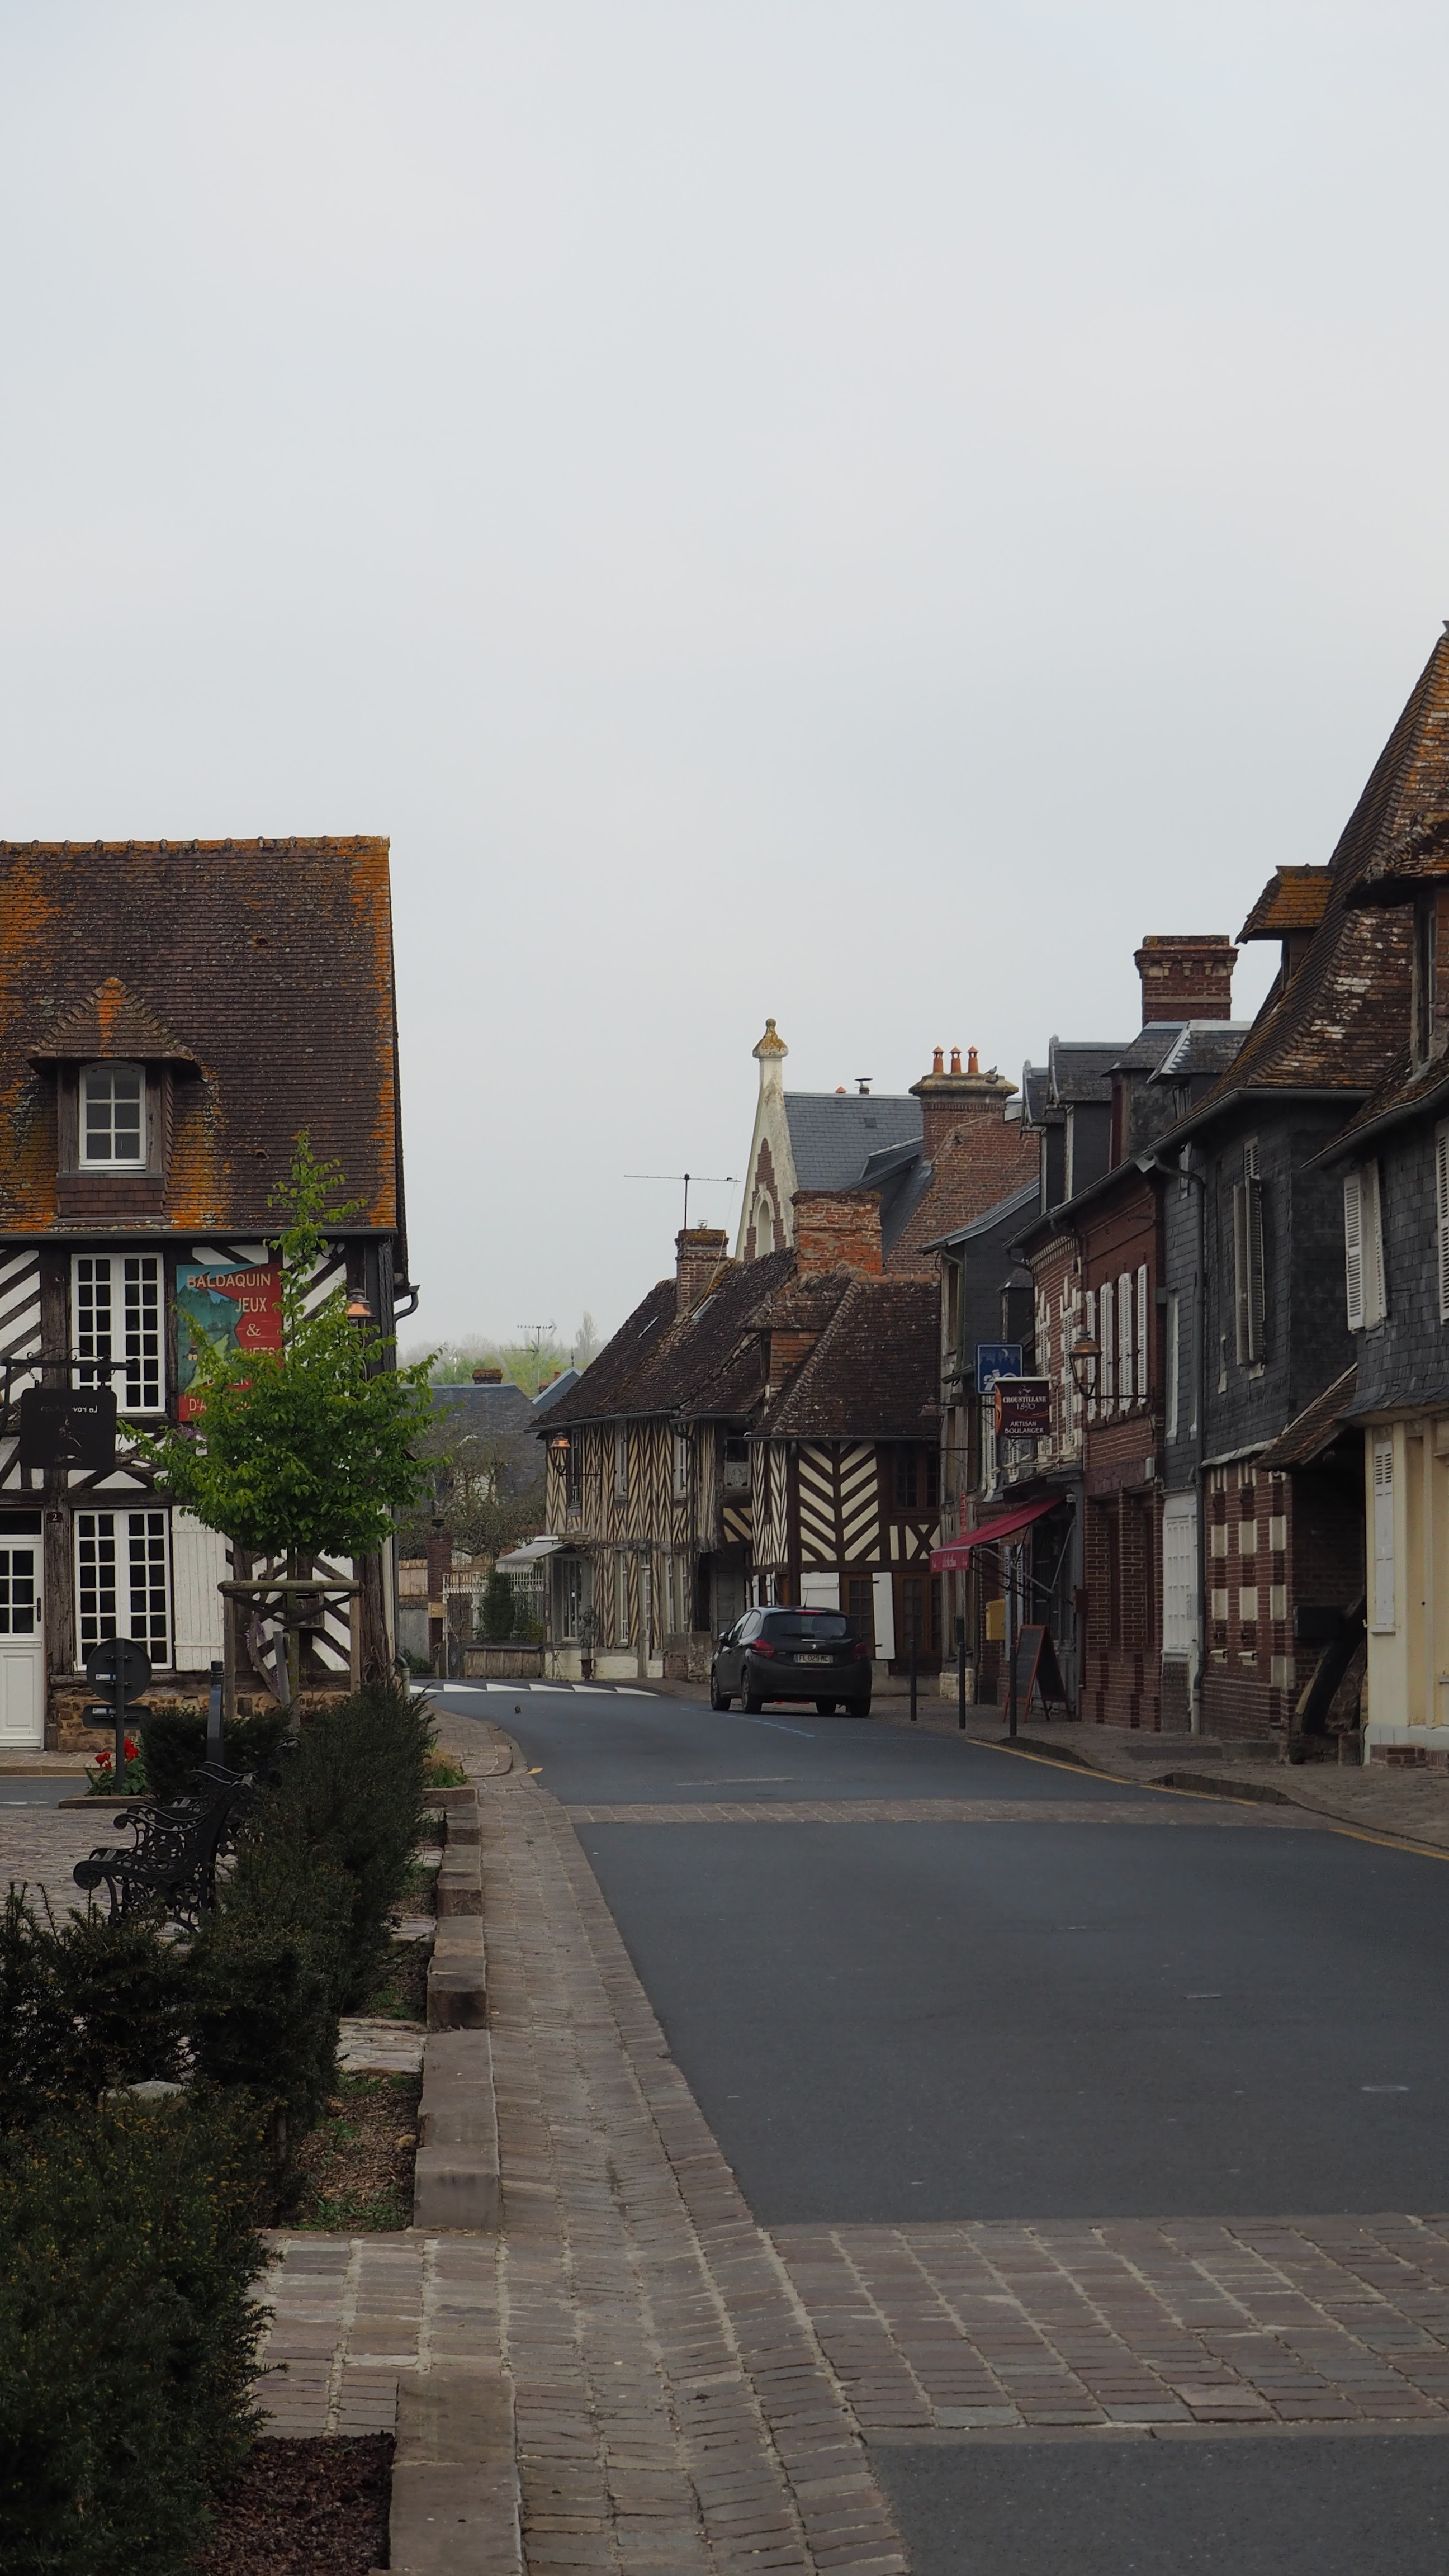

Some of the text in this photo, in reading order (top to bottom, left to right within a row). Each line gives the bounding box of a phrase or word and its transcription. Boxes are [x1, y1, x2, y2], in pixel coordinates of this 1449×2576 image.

[187, 1273, 271, 1287] BALDAQUIN
[235, 1297, 267, 1312] JEUX
[246, 1323, 261, 1337] &
[1016, 1403, 1035, 1412] 1890
[52, 1513, 58, 1521] 2
